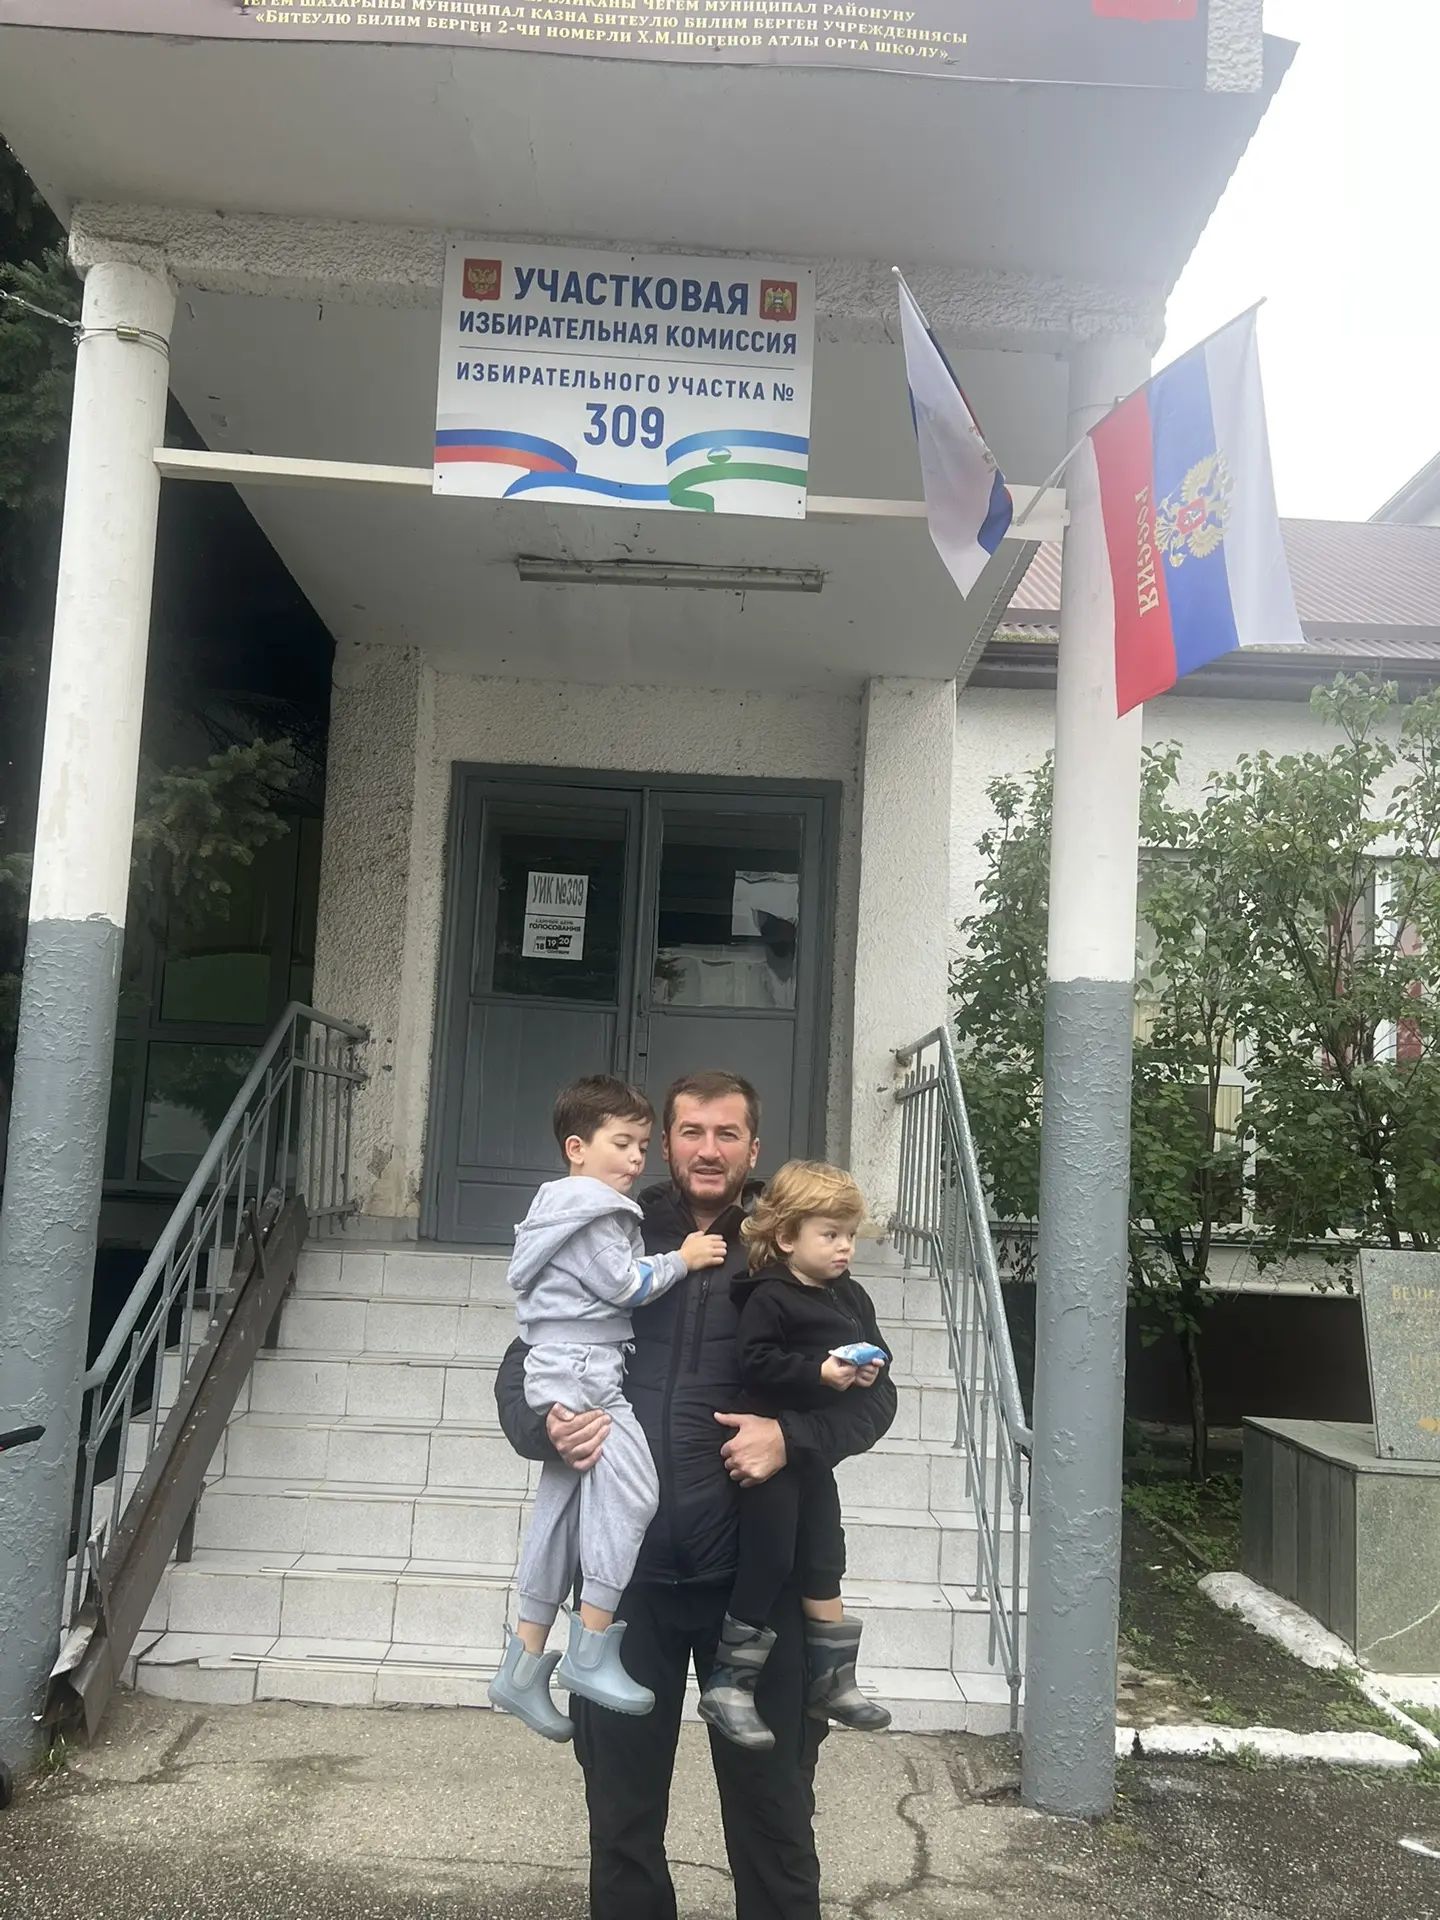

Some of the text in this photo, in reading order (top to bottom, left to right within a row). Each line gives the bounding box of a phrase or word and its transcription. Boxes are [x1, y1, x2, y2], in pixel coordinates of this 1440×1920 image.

[300, 0, 405, 9] ШАХАРЫНЫ
[411, 0, 524, 19] МУНИЦИПАЛ
[531, 8, 587, 22] КАЗНА
[594, 14, 678, 27] БИТЕУЛЮ
[685, 17, 747, 28] БИЛИМ
[754, 18, 817, 30] БЕРГЕН
[824, 24, 967, 43] УЧРЕЖДЕНИЯСЫ
[644, 0, 698, 11] ЧЕГЕМ
[705, 1, 816, 14] МУНИЦИПАЛ
[823, 4, 915, 22] РАЙОНУНУ
[357, 14, 420, 27] БИЛИМ
[427, 17, 491, 32] БЕРГЕН
[498, 20, 540, 35] 2-ЧИ
[547, 27, 631, 42] НОМЕРЛИ
[638, 31, 762, 46] Х.М.ШОГЕНОВ
[768, 36, 818, 46] АТЛЫ
[825, 37, 868, 50] ОРТА
[875, 43, 949, 59] ШКОЛУ»
[514, 267, 749, 315] УЧАСТКОВАЯ
[459, 311, 796, 354] ИЗБИРАТЕЛЬНАЯ КОМИССИЯ
[457, 362, 793, 401] ИЗБИРАТЕЛЬНОГО УЧАСТКА №
[583, 403, 664, 449] 309
[1135, 486, 1159, 616] РОССИЯ
[533, 875, 584, 906] УИК №309
[529, 922, 581, 931] ГОЛОСОВАНИЯ
[536, 937, 570, 951] 18 19 20
